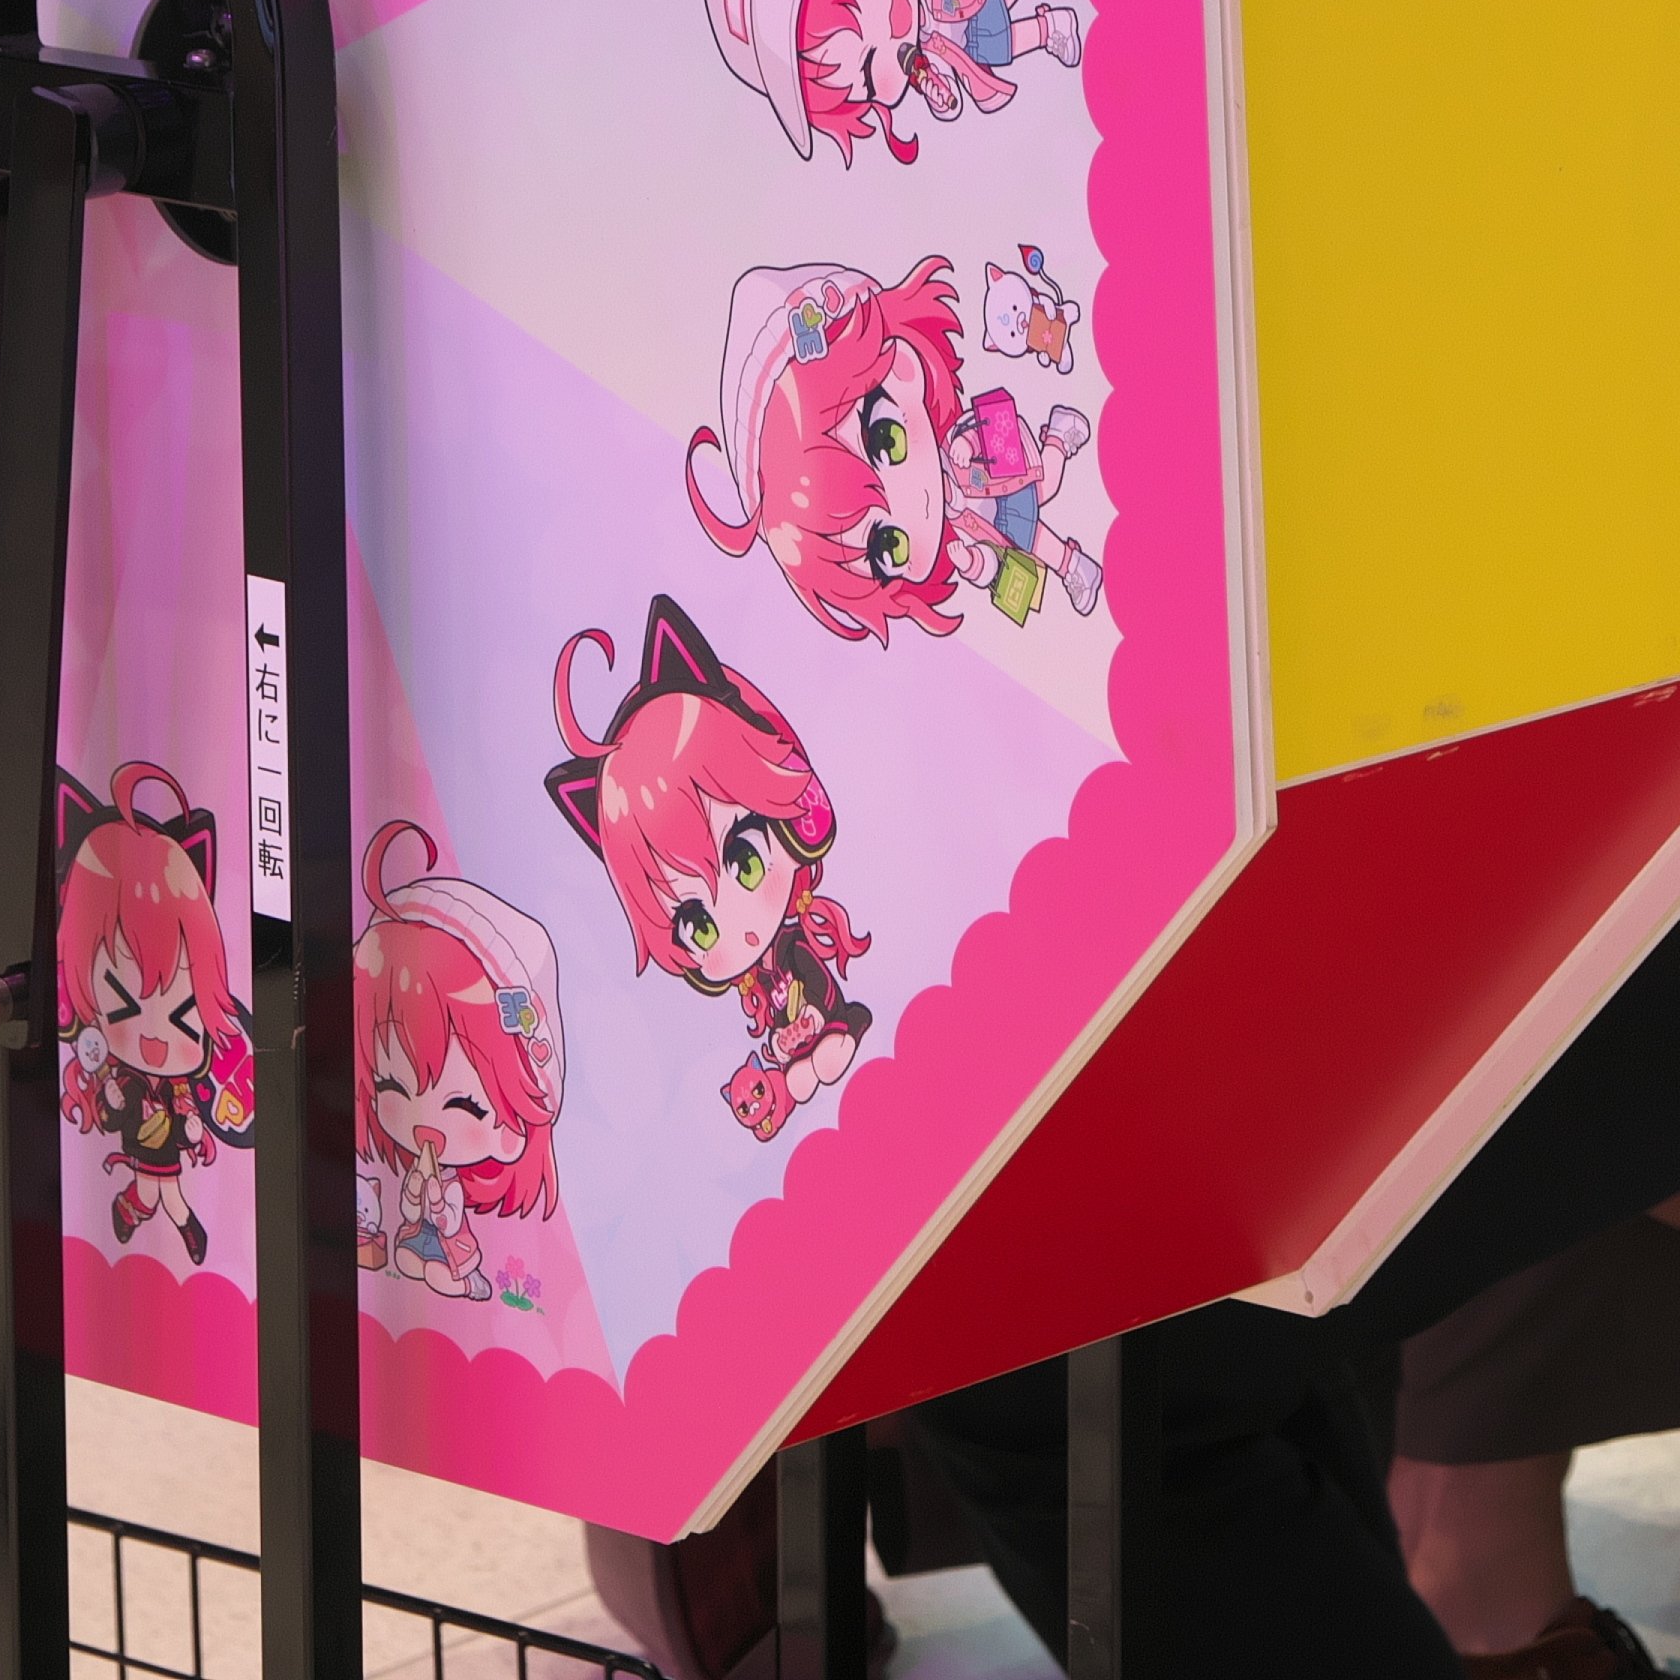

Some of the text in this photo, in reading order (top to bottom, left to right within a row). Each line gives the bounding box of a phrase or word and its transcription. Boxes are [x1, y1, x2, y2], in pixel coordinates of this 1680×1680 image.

[255, 663, 285, 881] 右に一回転
